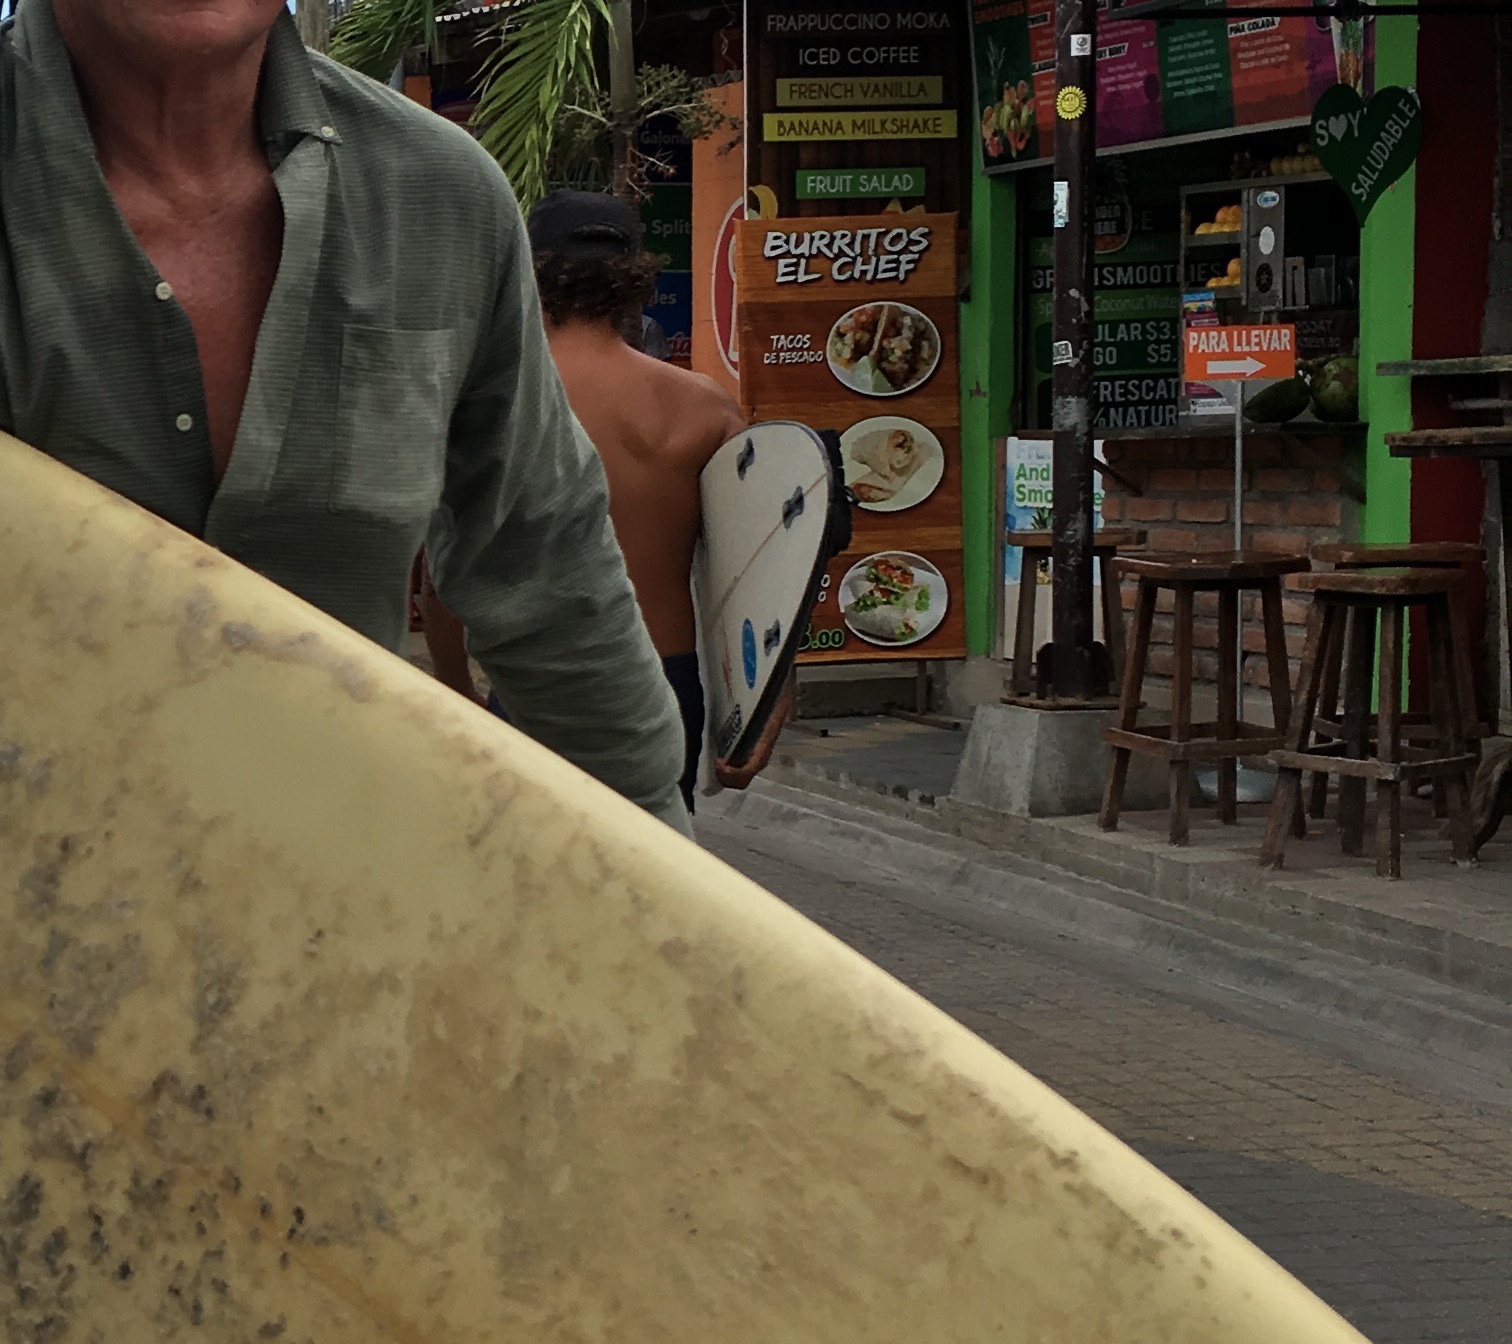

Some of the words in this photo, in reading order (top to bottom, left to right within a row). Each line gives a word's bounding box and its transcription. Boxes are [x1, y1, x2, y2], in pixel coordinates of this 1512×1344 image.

[767, 12, 891, 32] FRAPPUCCINO
[897, 11, 951, 30] MOKA
[1247, 17, 1276, 31] COLADA
[798, 47, 840, 65] ICED
[847, 46, 920, 64] COFFEE
[789, 82, 853, 100] FRENCH
[859, 80, 928, 99] VANILLA
[776, 119, 845, 137] BANANA
[851, 117, 943, 136] MILKSHAKE
[1350, 97, 1417, 203] SALUDABLE
[806, 175, 853, 194] FRUIT
[858, 173, 914, 192] SALAD
[651, 218, 690, 239] Split
[763, 227, 930, 258] BURRITOS
[776, 258, 822, 283] EL
[831, 253, 921, 282] CHEF
[1146, 294, 1179, 310] Wate
[769, 333, 812, 351] TACOS
[1188, 330, 1230, 354] PARA
[1232, 328, 1291, 353] LLEVAR
[763, 352, 778, 365] DE
[778, 350, 824, 365] PESCADO
[1015, 463, 1051, 482] And
